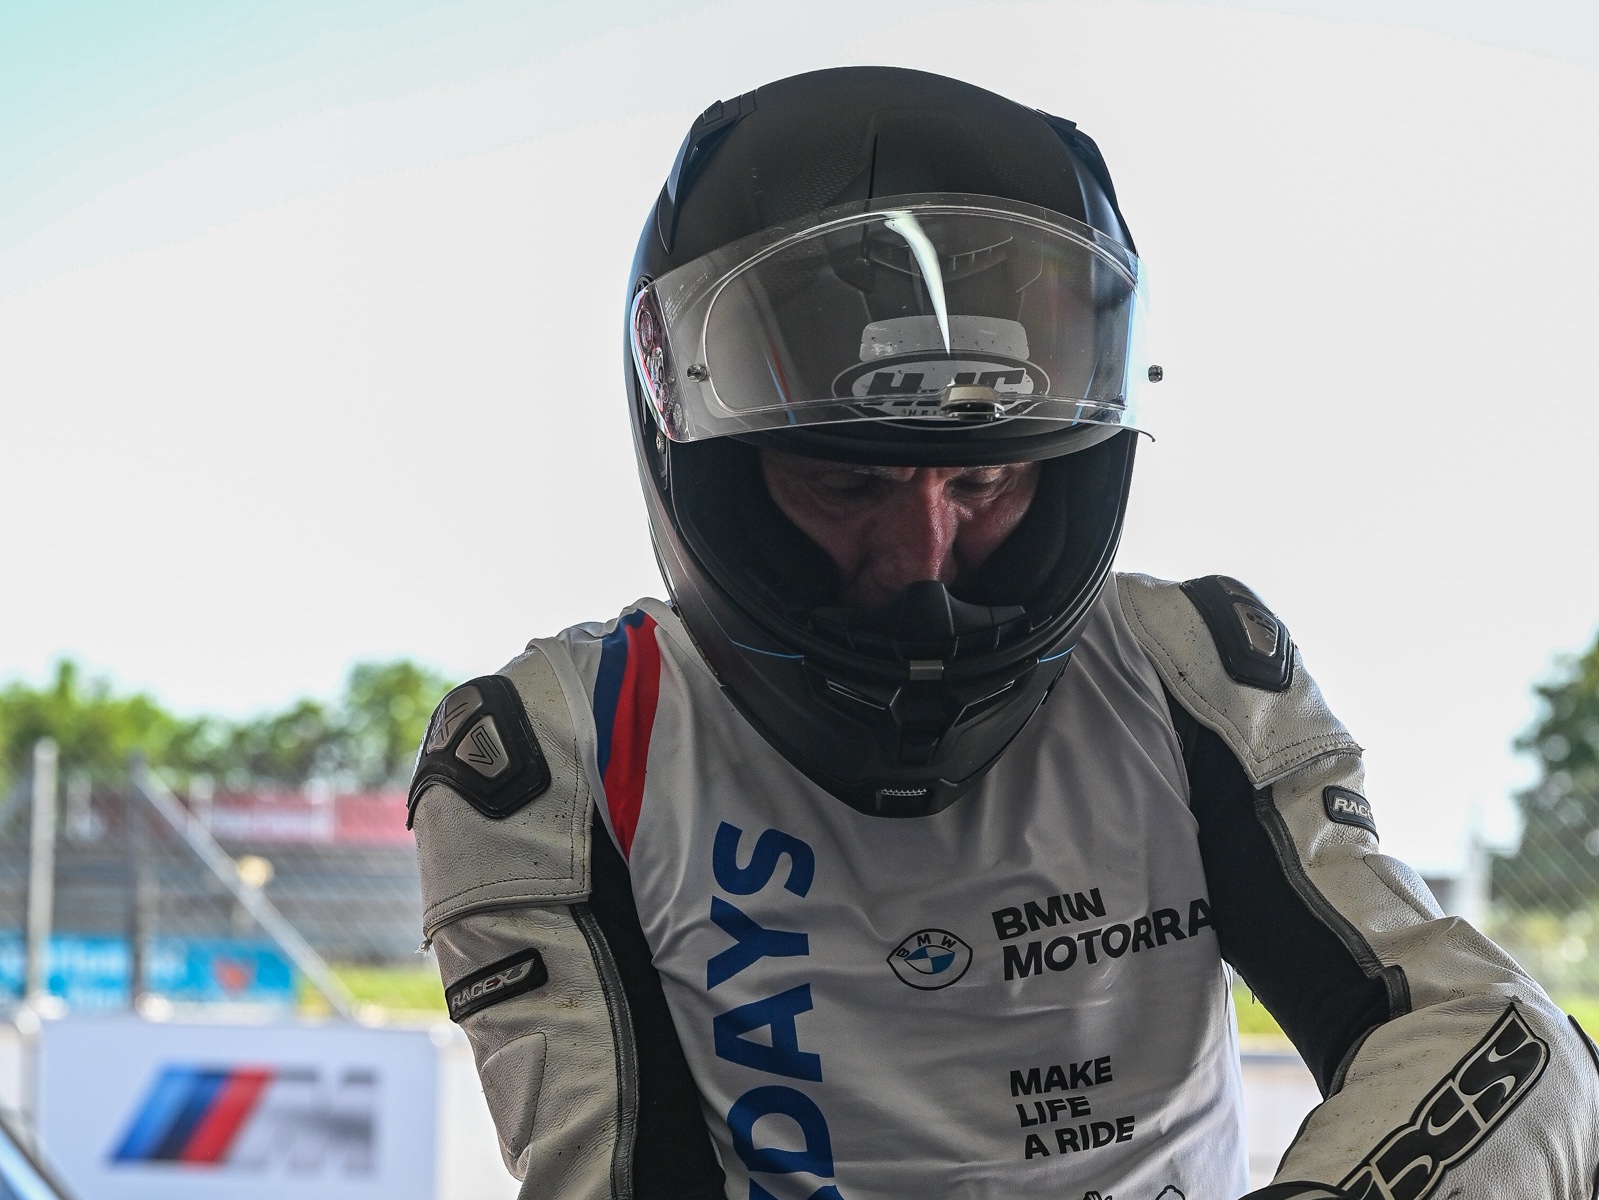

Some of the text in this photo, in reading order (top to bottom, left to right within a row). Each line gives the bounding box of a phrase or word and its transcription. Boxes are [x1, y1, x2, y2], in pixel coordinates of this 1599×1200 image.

[991, 887, 1107, 940] BMW
[896, 933, 957, 958] BMW
[1002, 897, 1217, 981] MOTORRA
[1010, 1055, 1113, 1097] MAKE
[1015, 1095, 1091, 1128] LIFE
[1025, 1115, 1136, 1160] A RIDE
